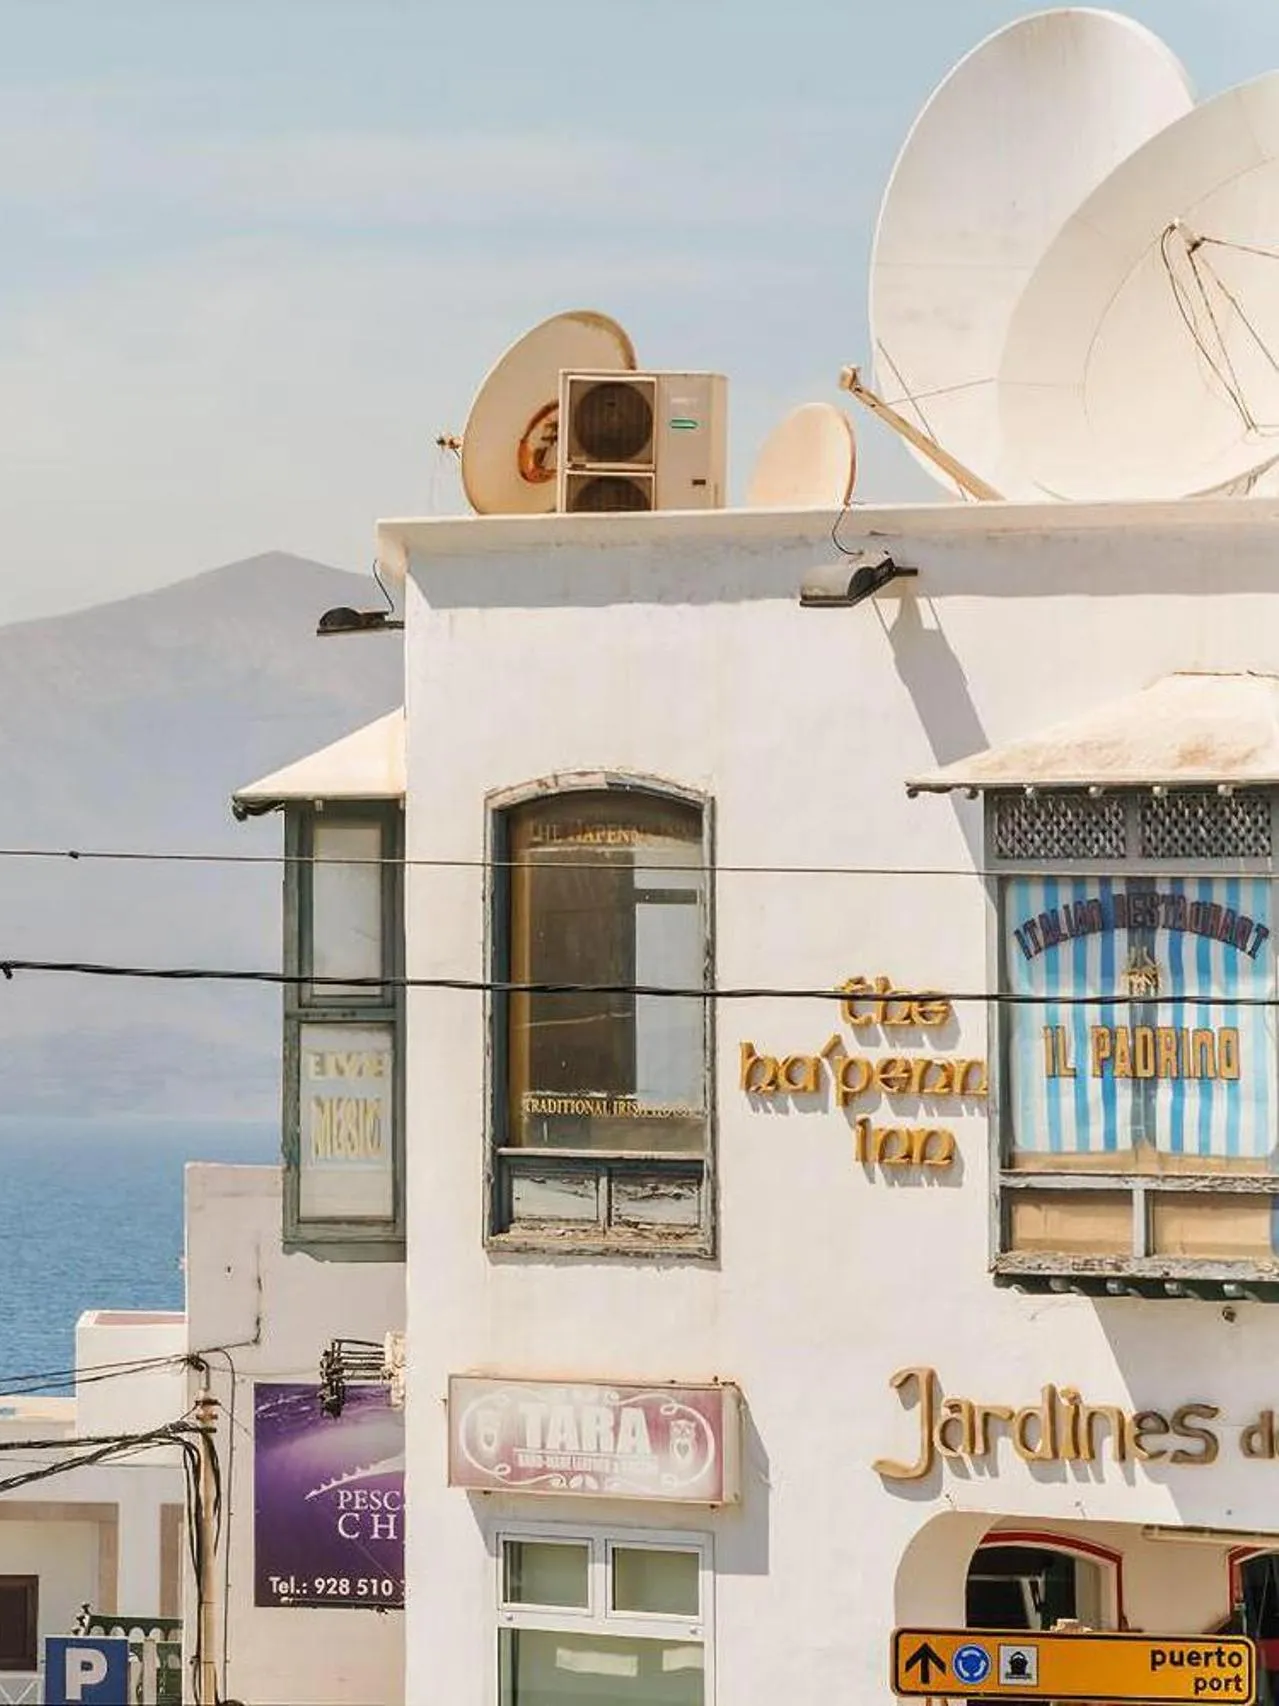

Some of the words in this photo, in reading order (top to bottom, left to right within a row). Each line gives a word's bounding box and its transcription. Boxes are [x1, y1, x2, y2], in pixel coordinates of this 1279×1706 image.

[837, 975, 951, 1026] the
[1042, 1025, 1077, 1079] IL
[523, 1098, 609, 1118] TRADITIONAL
[518, 1402, 653, 1455] TARA
[871, 1366, 1220, 1480] Jardines
[1239, 1410, 1279, 1460] d
[337, 1489, 406, 1512] PESC
[269, 1576, 308, 1595] Tel.:
[314, 1578, 350, 1596] 928
[357, 1579, 393, 1597] 510
[65, 1647, 108, 1700] P
[1150, 1648, 1244, 1672] puerto
[1193, 1673, 1244, 1695] port
